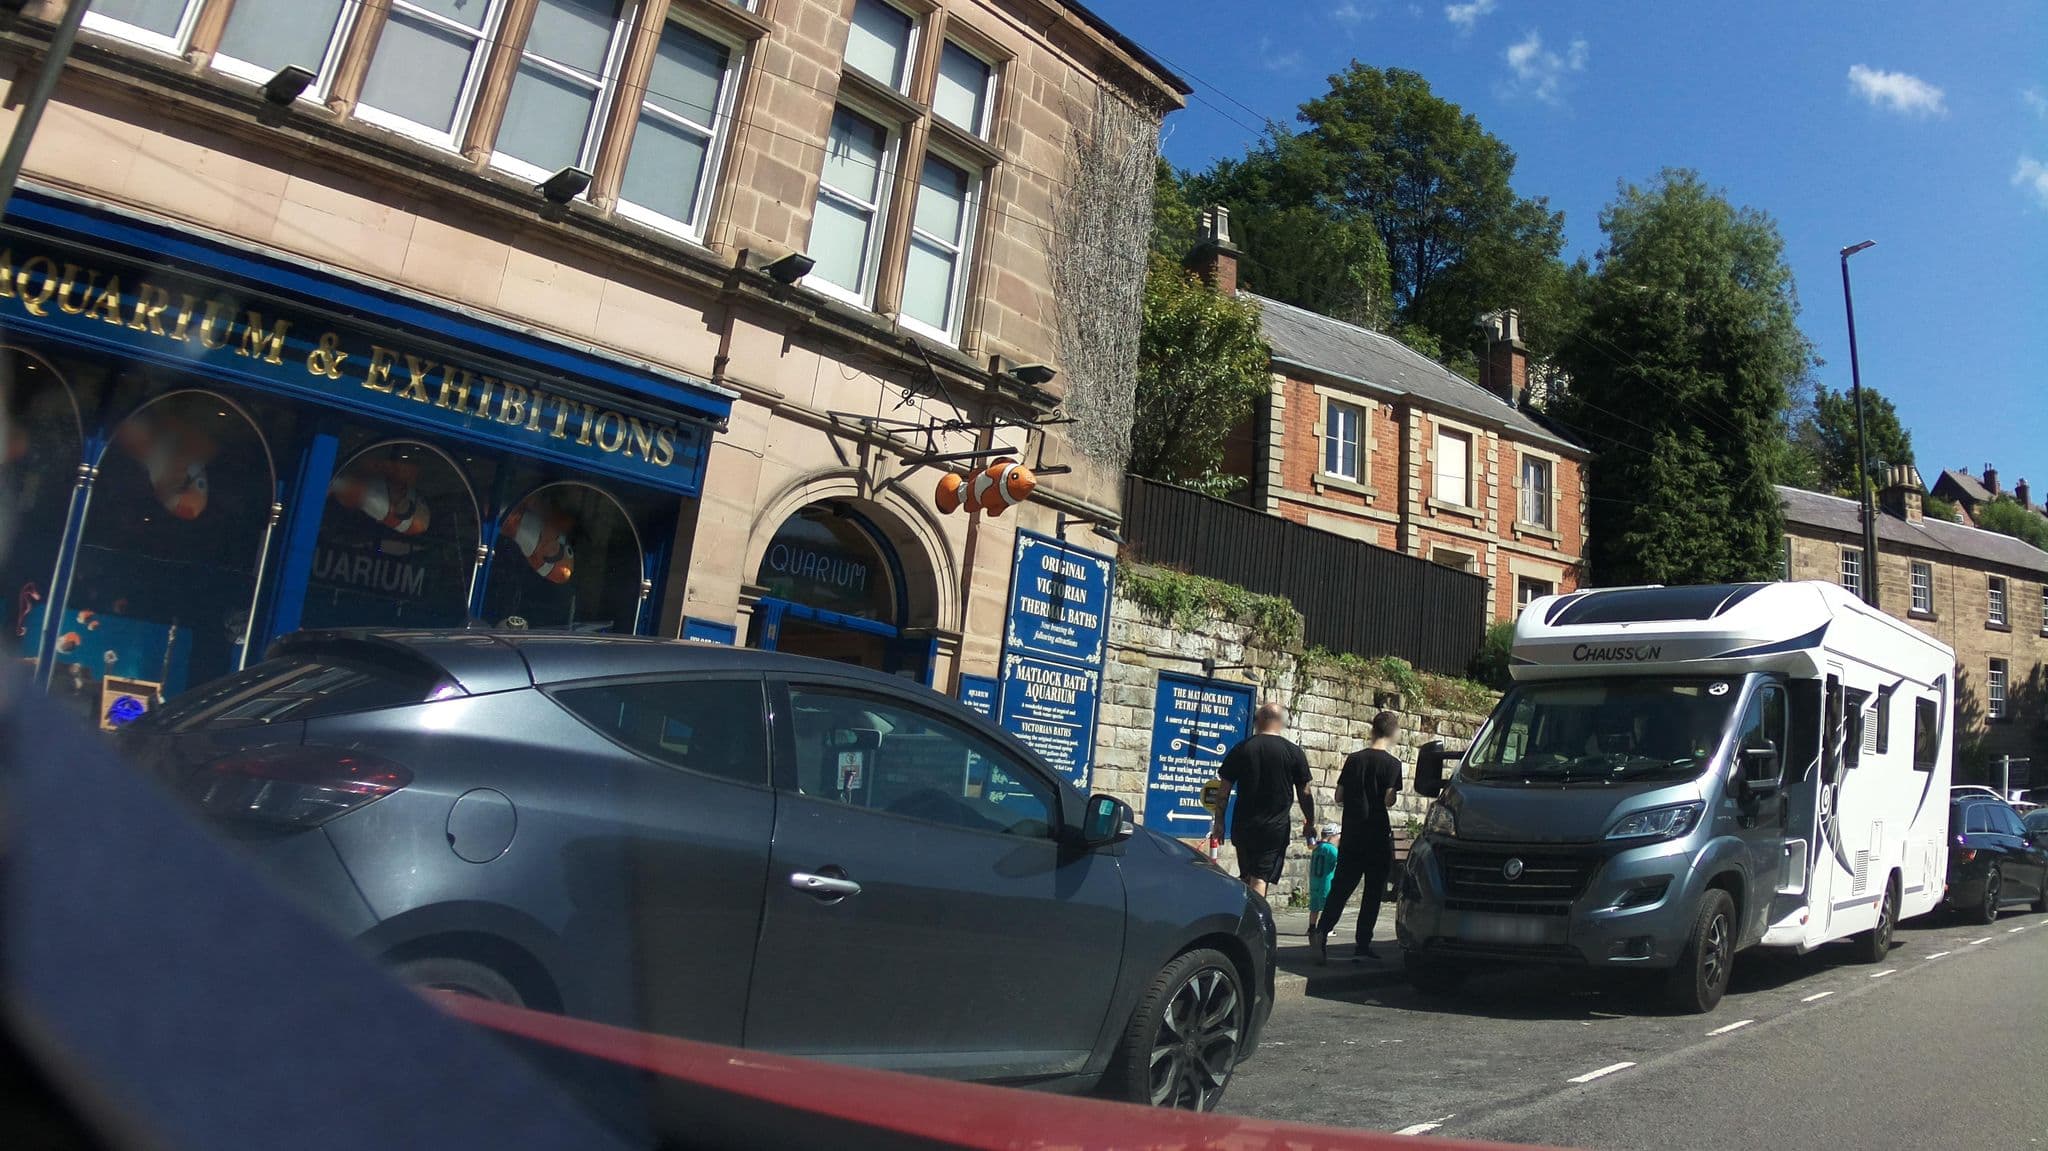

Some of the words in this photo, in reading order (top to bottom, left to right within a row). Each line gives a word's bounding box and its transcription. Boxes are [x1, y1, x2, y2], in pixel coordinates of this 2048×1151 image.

[306, 332, 349, 380] &
[361, 345, 678, 467] EXHIBITIONS
[312, 548, 426, 597] UARIUM
[763, 543, 867, 592] QUARIUM
[1041, 555, 1087, 581] ORIGINAL
[1037, 576, 1088, 604] VICTORIAN
[1020, 596, 1066, 623] THERMAL
[1067, 607, 1098, 630] BATHS
[1015, 665, 1062, 687] MATLOCK
[1063, 673, 1088, 692] BATH
[1025, 682, 1076, 705] AQUARIUM
[1173, 687, 1187, 698] THE
[1187, 690, 1217, 703] MATLOCK
[1217, 694, 1233, 706] BATH
[1213, 705, 1229, 717] WELL
[1021, 722, 1053, 735] VICTORIAN
[1053, 726, 1072, 737] BATHS
[1179, 797, 1204, 807] ENTRAN
